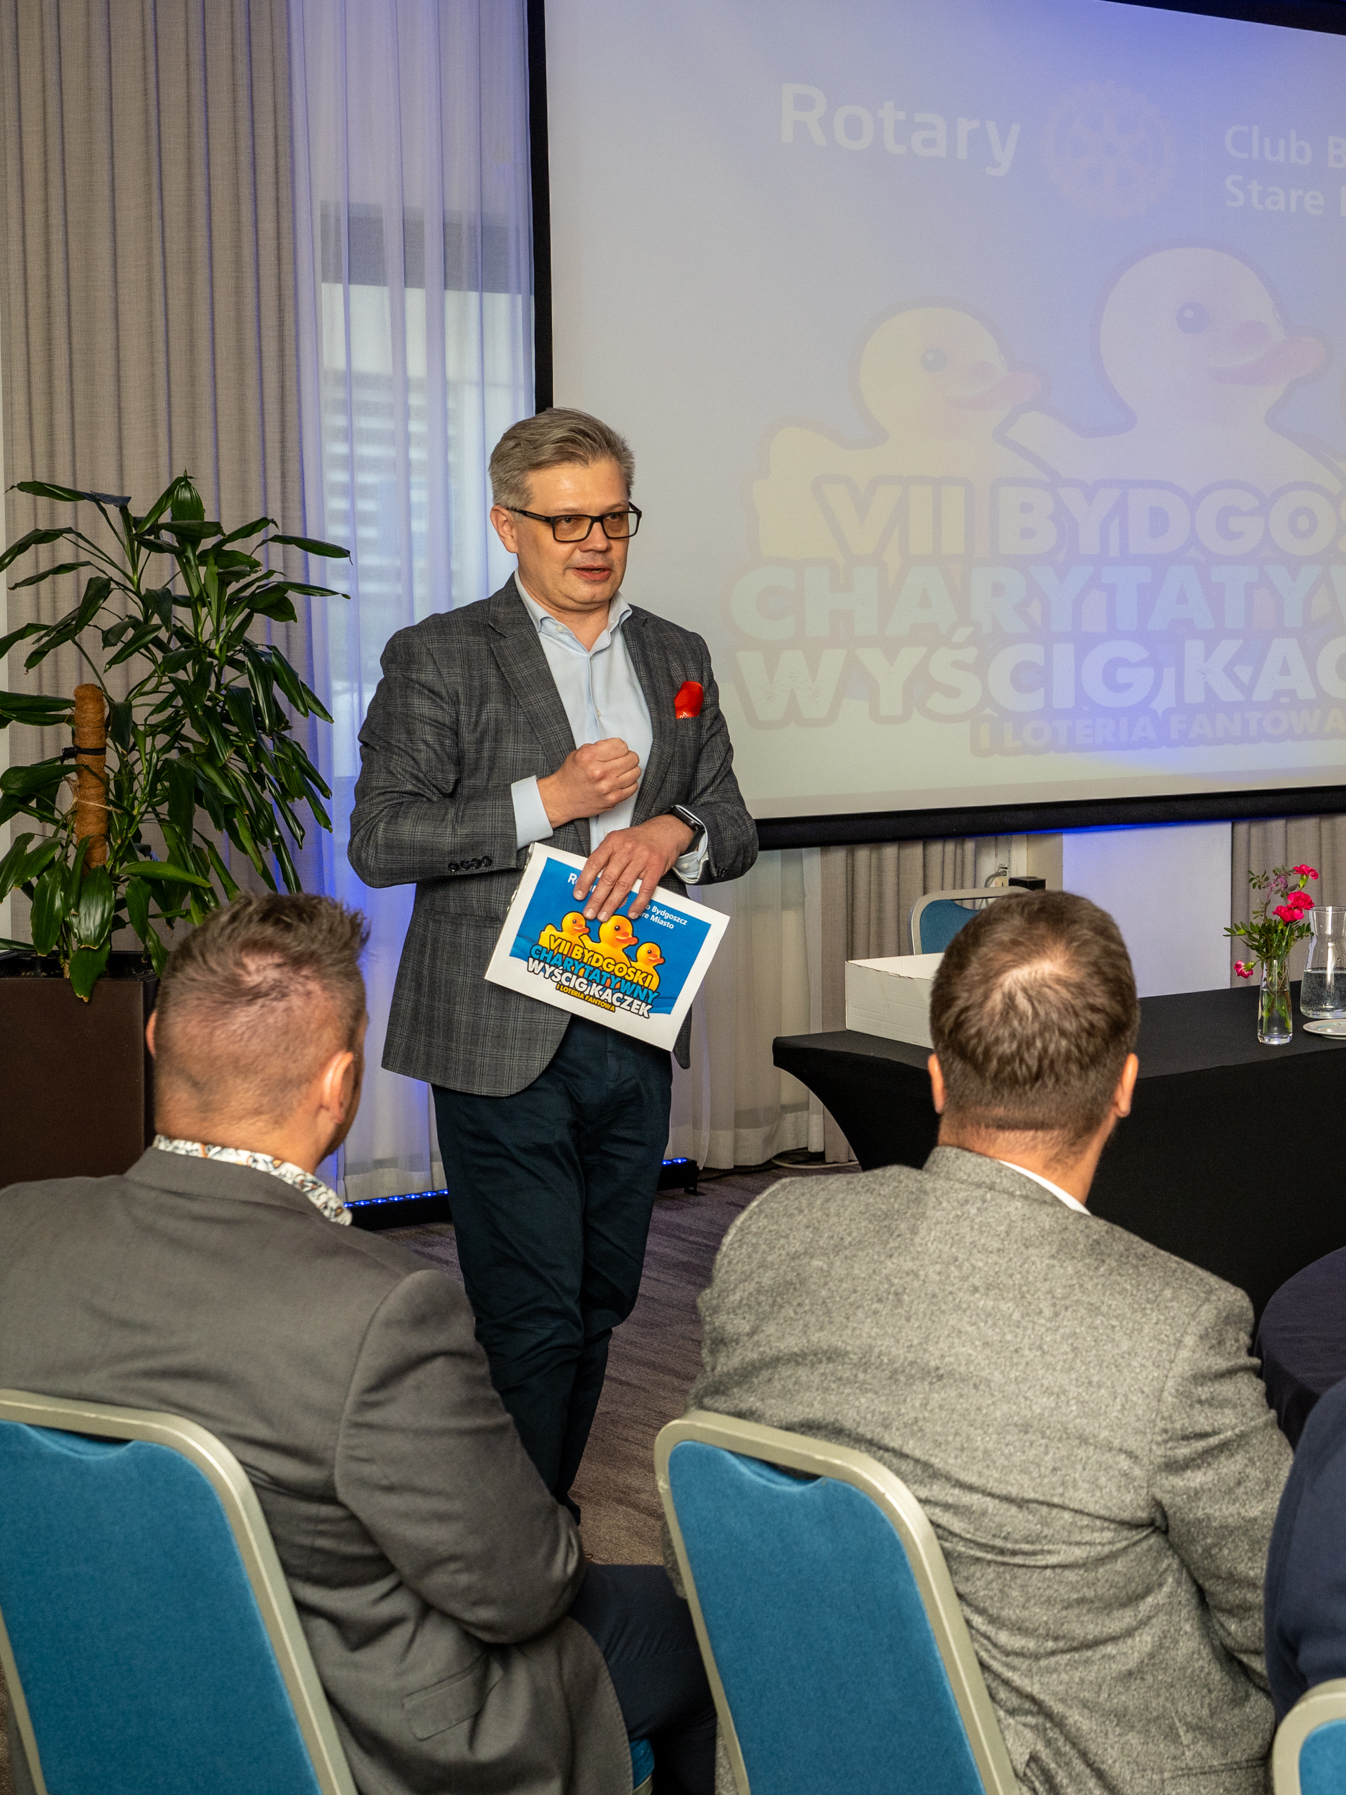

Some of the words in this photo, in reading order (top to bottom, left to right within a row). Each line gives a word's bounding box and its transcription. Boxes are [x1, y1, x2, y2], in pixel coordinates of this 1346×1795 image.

[781, 83, 1021, 177] Rotary
[1224, 124, 1313, 166] Club
[1224, 174, 1325, 215] Stare
[821, 484, 966, 556] VII
[735, 626, 1155, 722] WYŚCIG
[1003, 714, 1157, 748] LOTERIA
[650, 914, 675, 930] Miasto
[651, 905, 688, 926] Bydgoszcz
[530, 945, 659, 1004] CHARYTATYWNY
[549, 935, 572, 955] VII
[571, 945, 653, 987] BYDGOSKI
[560, 985, 584, 1000] LOTERIA
[585, 996, 616, 1012] FANTOWA
[590, 982, 653, 1018] KACZEK
